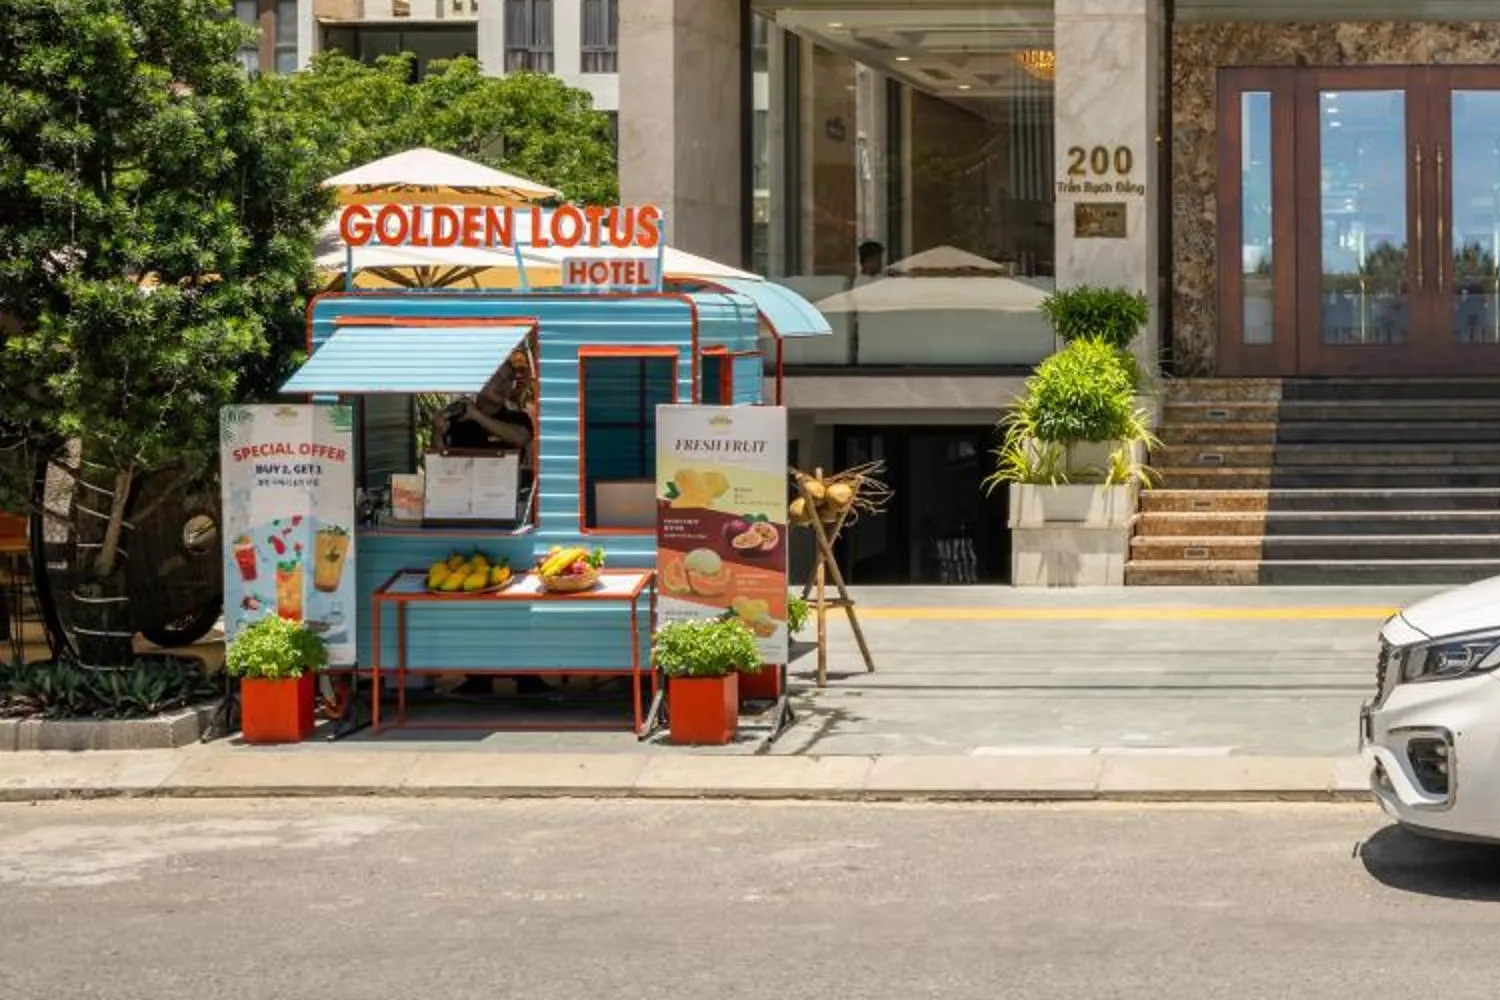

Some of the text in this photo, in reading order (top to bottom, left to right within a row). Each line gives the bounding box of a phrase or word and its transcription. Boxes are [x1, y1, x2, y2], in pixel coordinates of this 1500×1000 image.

[1067, 145, 1133, 175] 200
[340, 203, 661, 248] GOLDEN LOTUS
[569, 261, 649, 285] HOTEL
[232, 442, 346, 463] SPECIAL OFFER
[675, 439, 768, 453] FRESH FRUIT
[255, 463, 280, 475] BUY
[293, 464, 314, 474] GET
